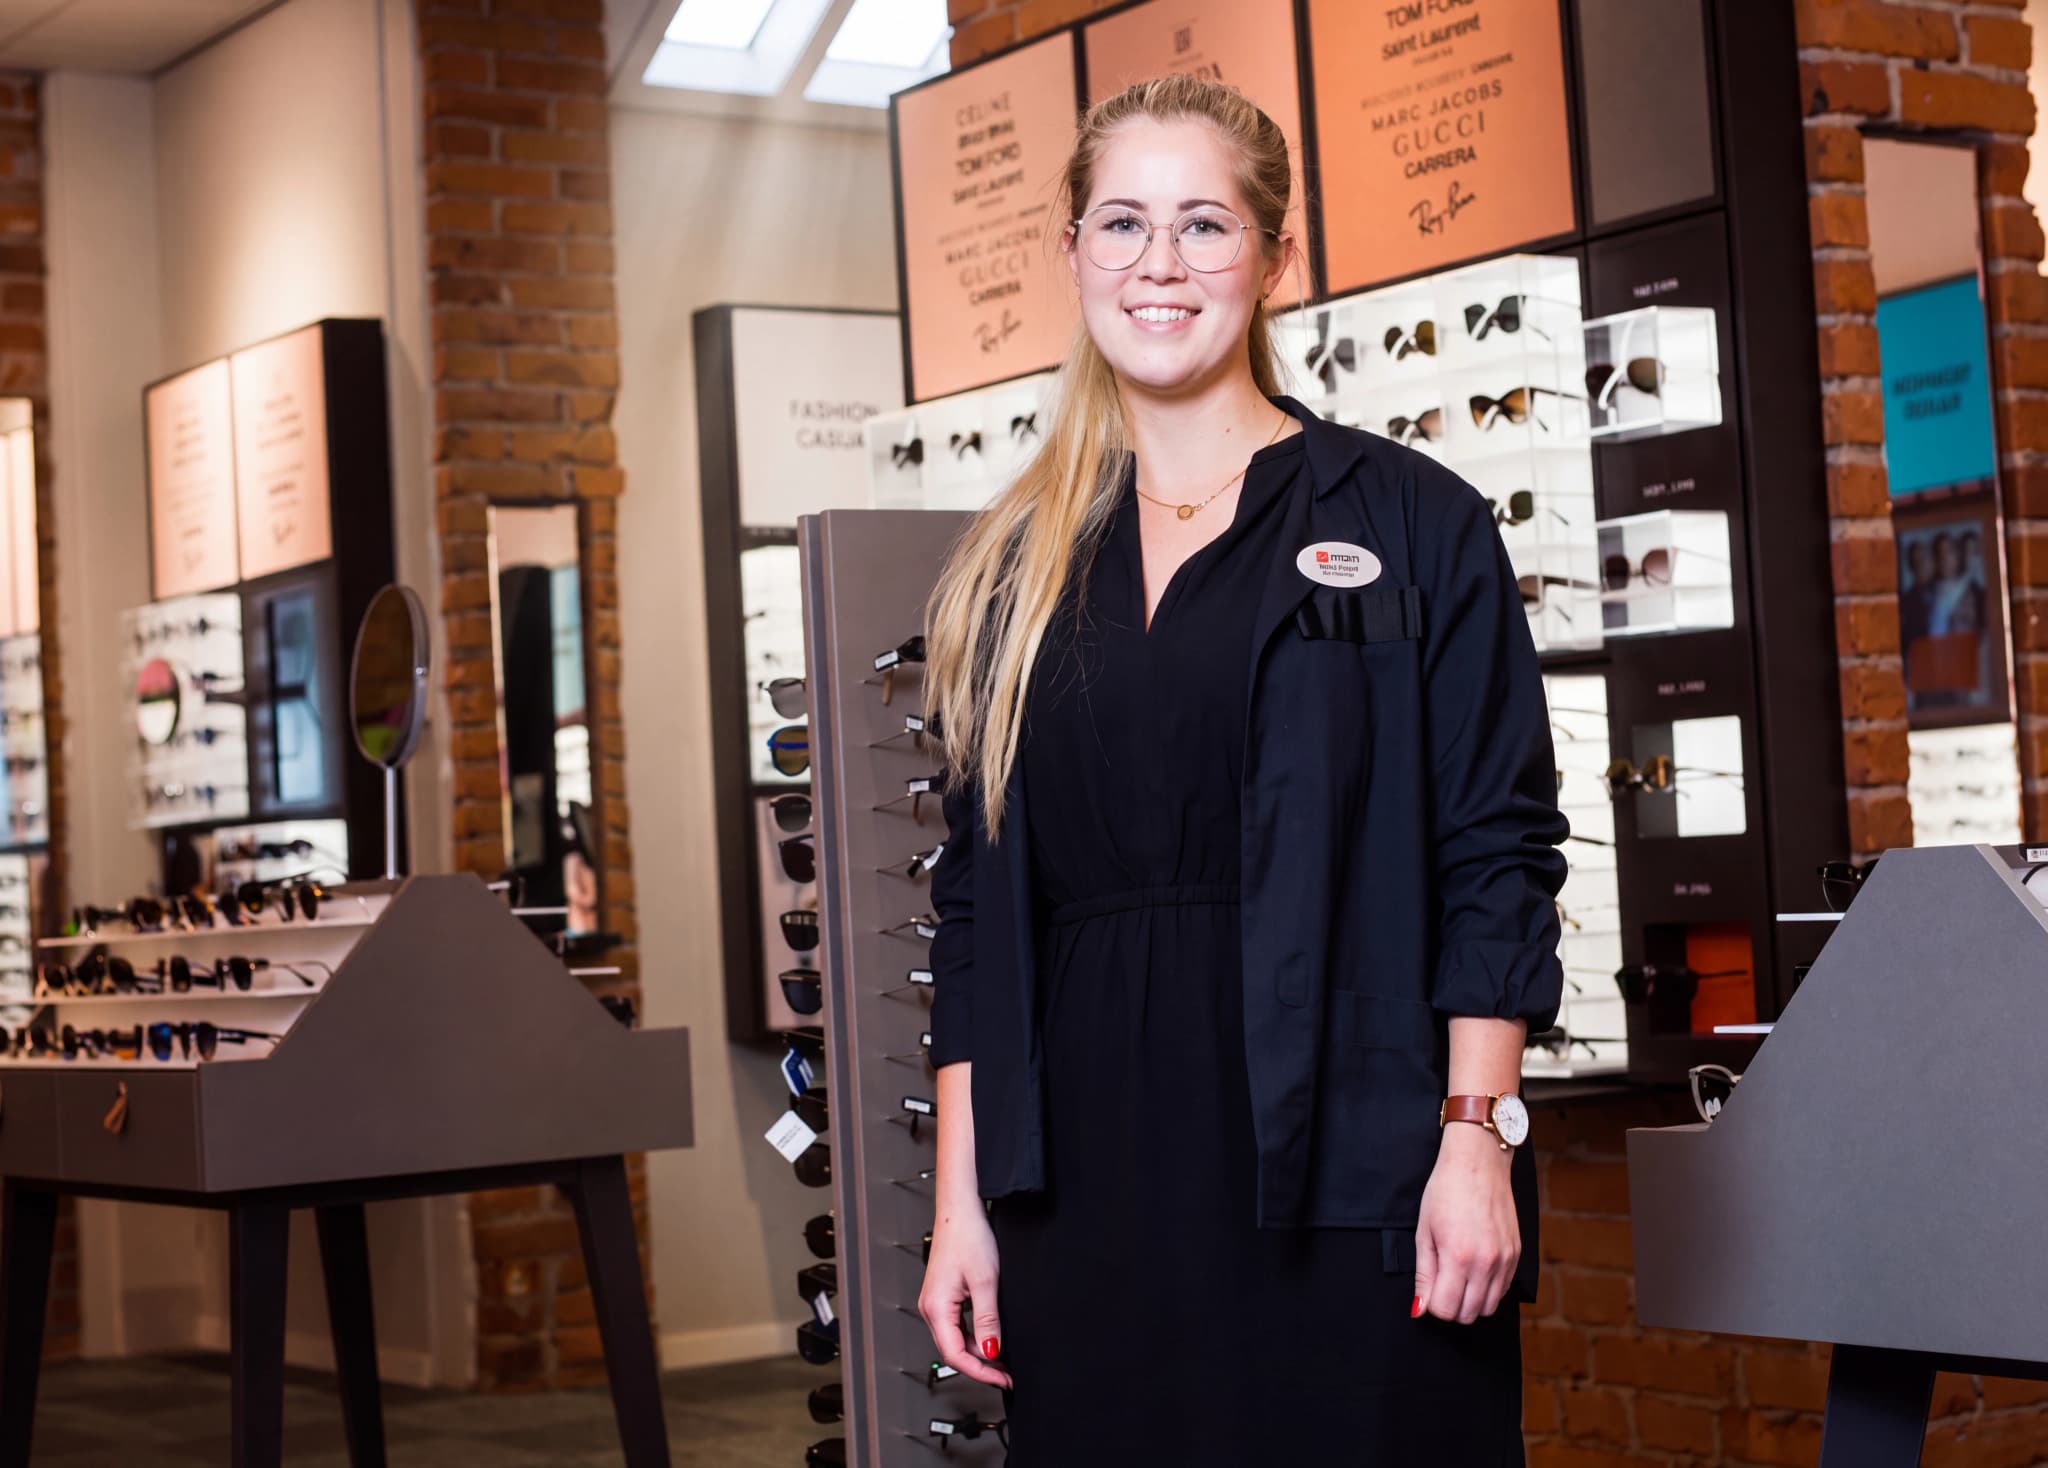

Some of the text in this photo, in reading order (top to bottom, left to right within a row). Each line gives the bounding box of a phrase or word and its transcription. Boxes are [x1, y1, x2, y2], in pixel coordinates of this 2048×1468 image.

[1385, 0, 1422, 30] TOM
[1382, 33, 1417, 61] Saint
[1419, 12, 1481, 49] Laurent
[1371, 104, 1421, 131] MARC
[1429, 79, 1503, 116] JACOBS
[1392, 109, 1486, 158] GUCCI
[1403, 145, 1477, 179] CARRERA
[795, 427, 865, 449] CASUA
